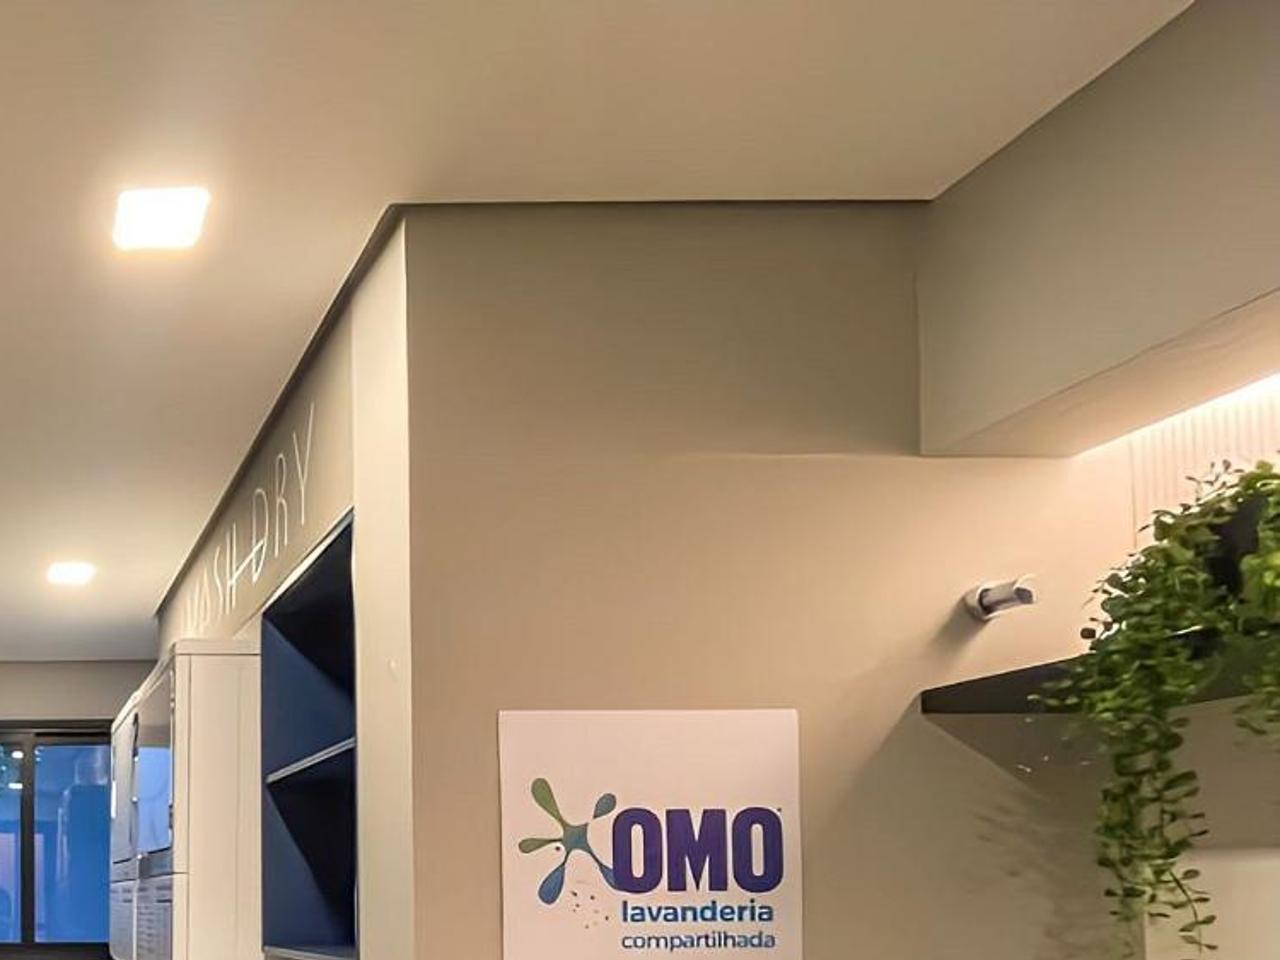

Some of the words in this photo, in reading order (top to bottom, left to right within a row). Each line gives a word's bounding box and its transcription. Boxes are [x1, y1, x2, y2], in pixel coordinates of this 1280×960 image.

[251, 401, 316, 583] DRY
[611, 806, 784, 894] OMO
[622, 898, 775, 923] lavanderia
[621, 930, 776, 952] compartilhada
